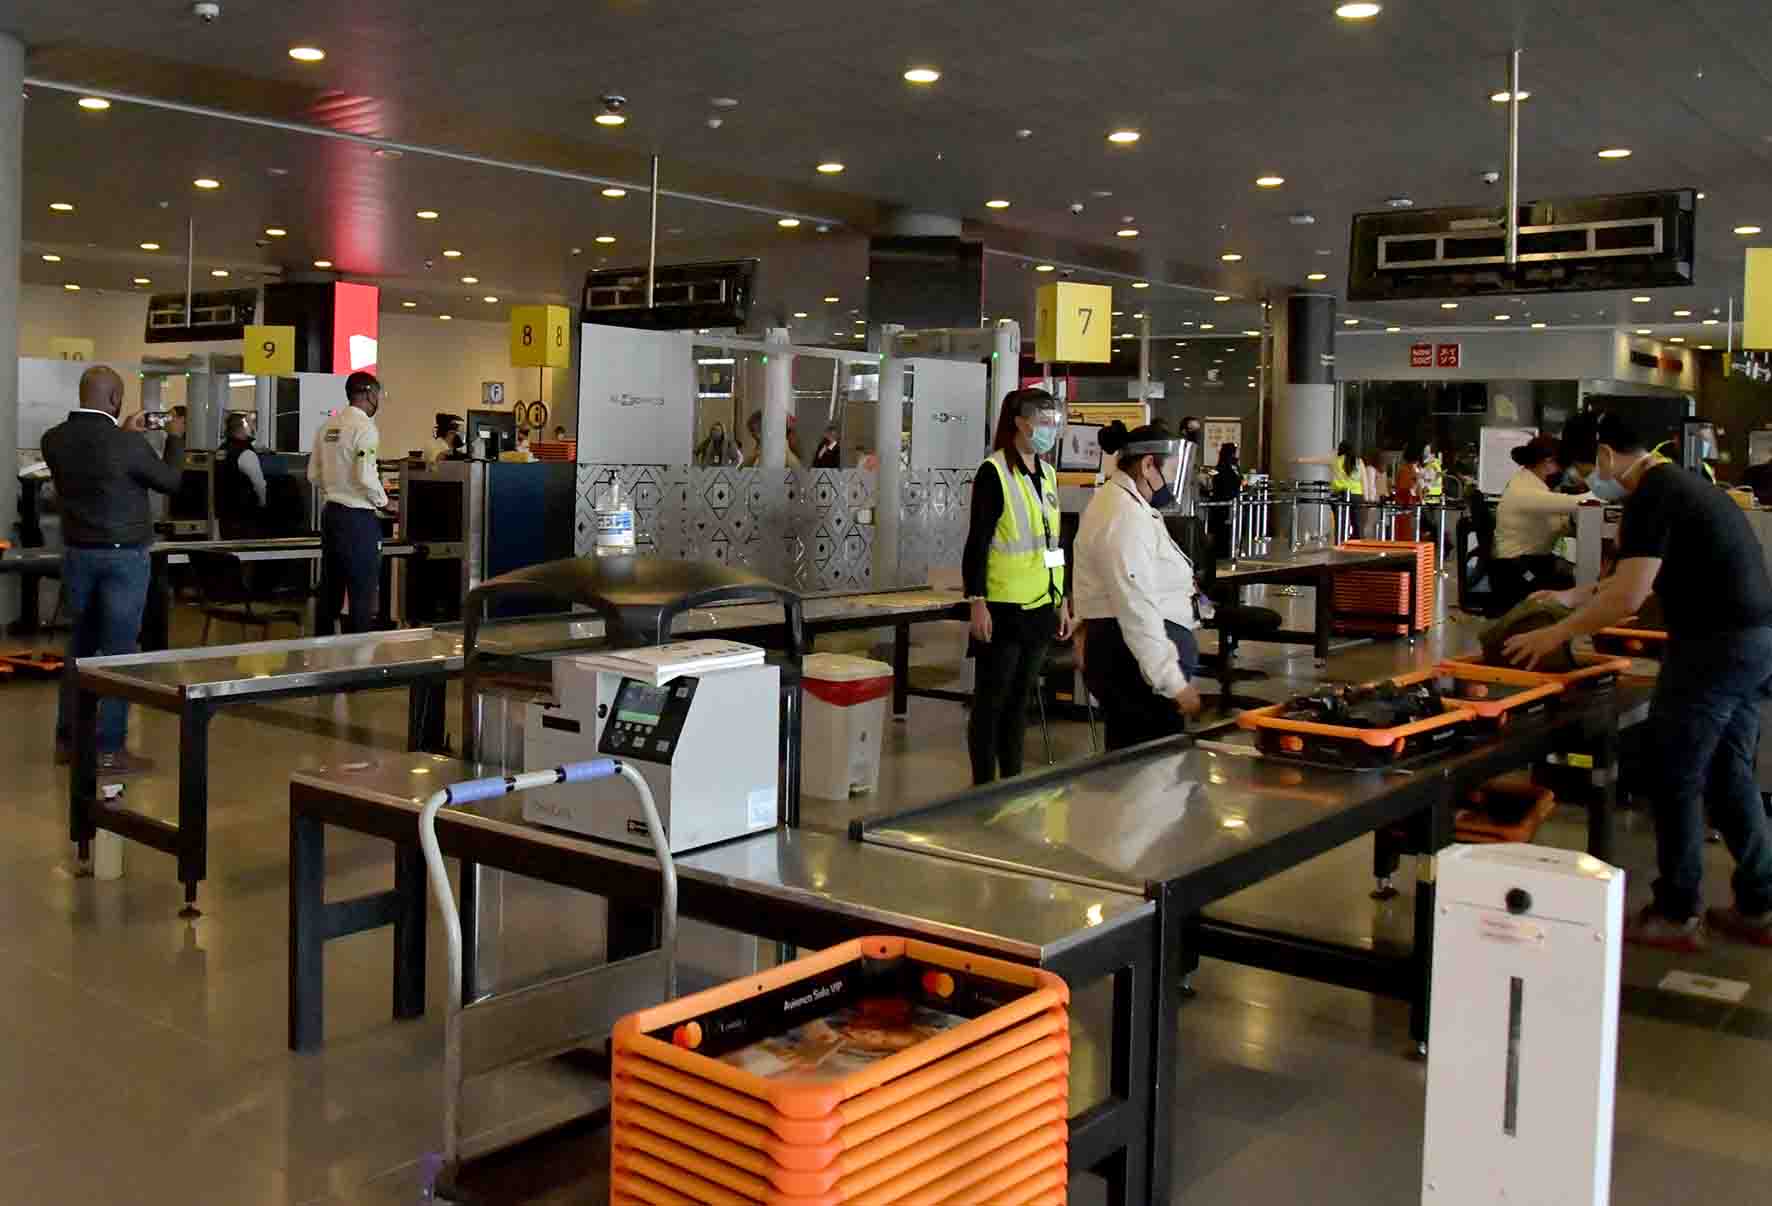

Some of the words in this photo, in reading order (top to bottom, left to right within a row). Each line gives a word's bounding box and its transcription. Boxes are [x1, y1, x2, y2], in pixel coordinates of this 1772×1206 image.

[1079, 308, 1093, 335] 7
[522, 325, 533, 346] 8
[556, 325, 563, 347] 8
[263, 341, 275, 359] 9
